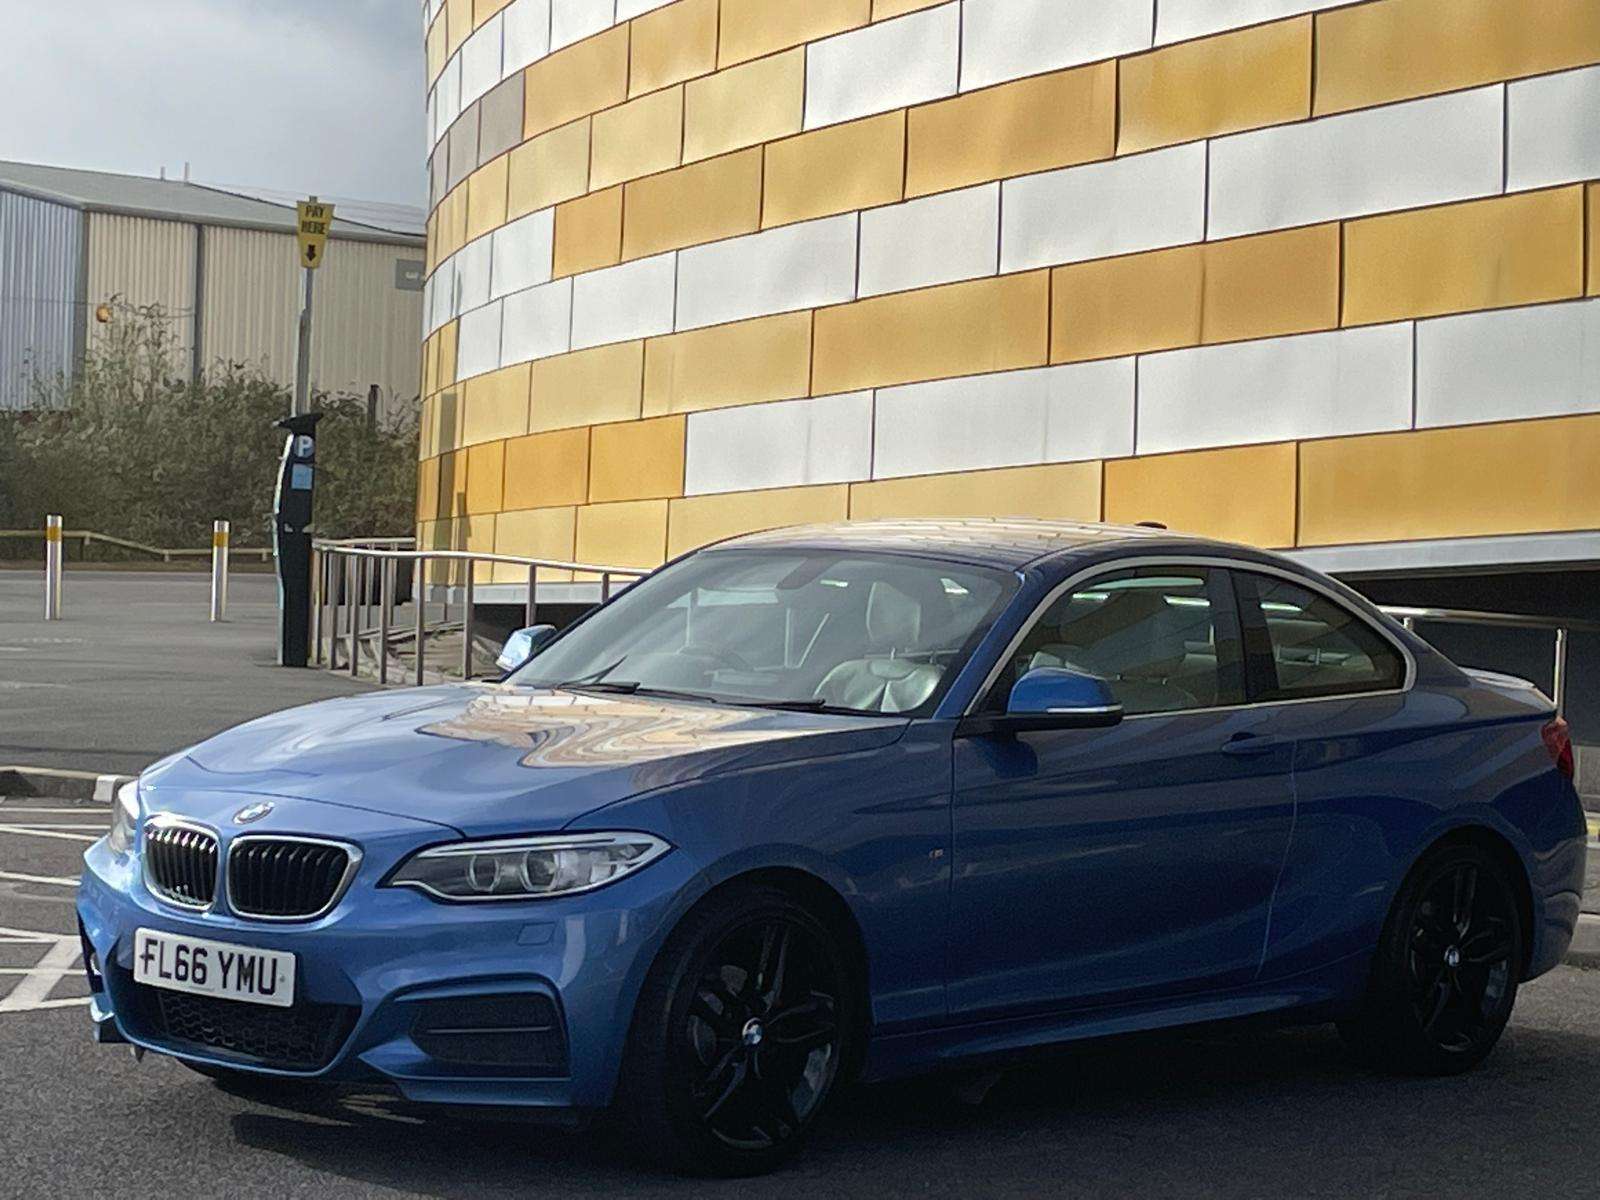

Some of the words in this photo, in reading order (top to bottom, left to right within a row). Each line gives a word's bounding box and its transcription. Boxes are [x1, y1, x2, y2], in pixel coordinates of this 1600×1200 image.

[305, 205, 323, 218] PAY
[301, 220, 326, 235] HERE
[298, 435, 313, 457] P
[140, 938, 208, 985] FL66
[218, 951, 278, 995] YMU
